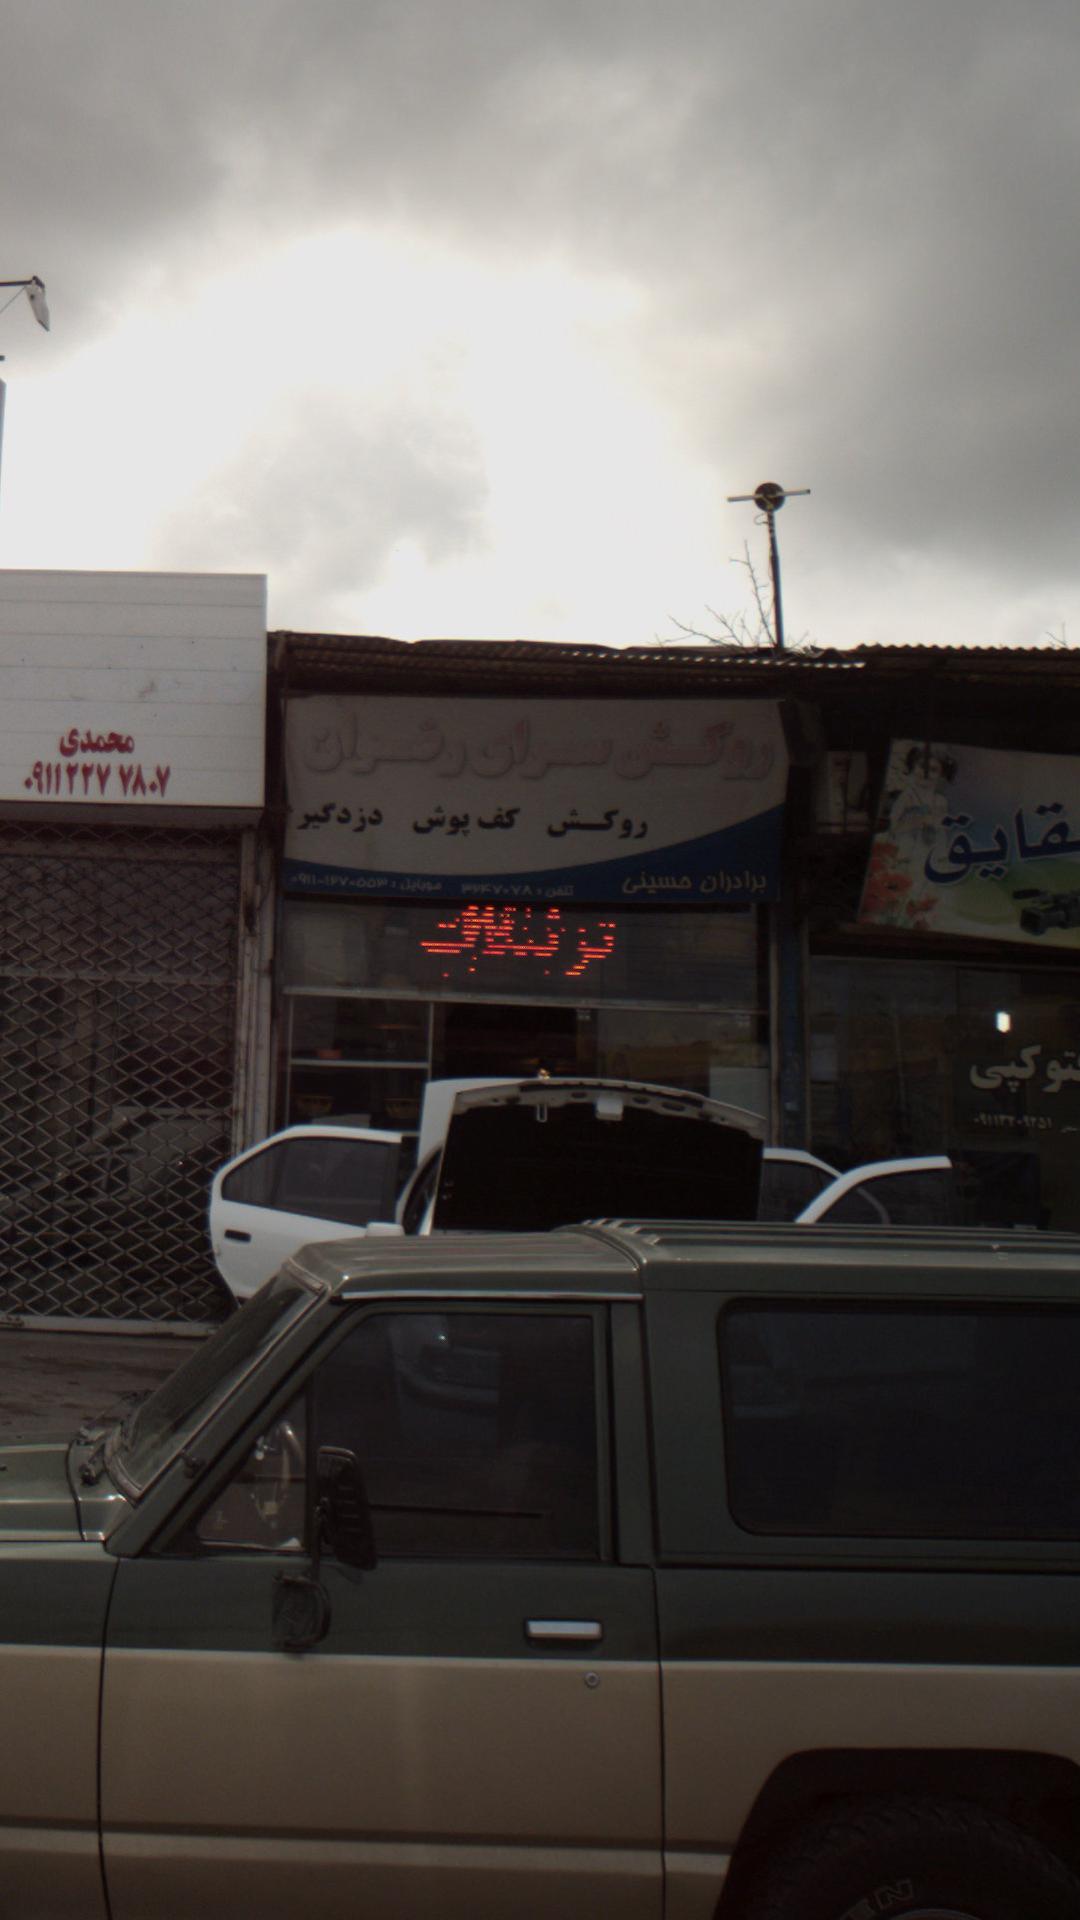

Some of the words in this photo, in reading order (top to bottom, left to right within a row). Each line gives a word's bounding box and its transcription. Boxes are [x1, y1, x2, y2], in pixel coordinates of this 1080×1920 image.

[59, 728, 135, 757] محمدی
[547, 809, 648, 838] روکش
[925, 802, 1080, 883] قایق
[622, 871, 692, 895] حسینی
[699, 868, 767, 894] برادران
[969, 1044, 1080, 1093] توکپی
